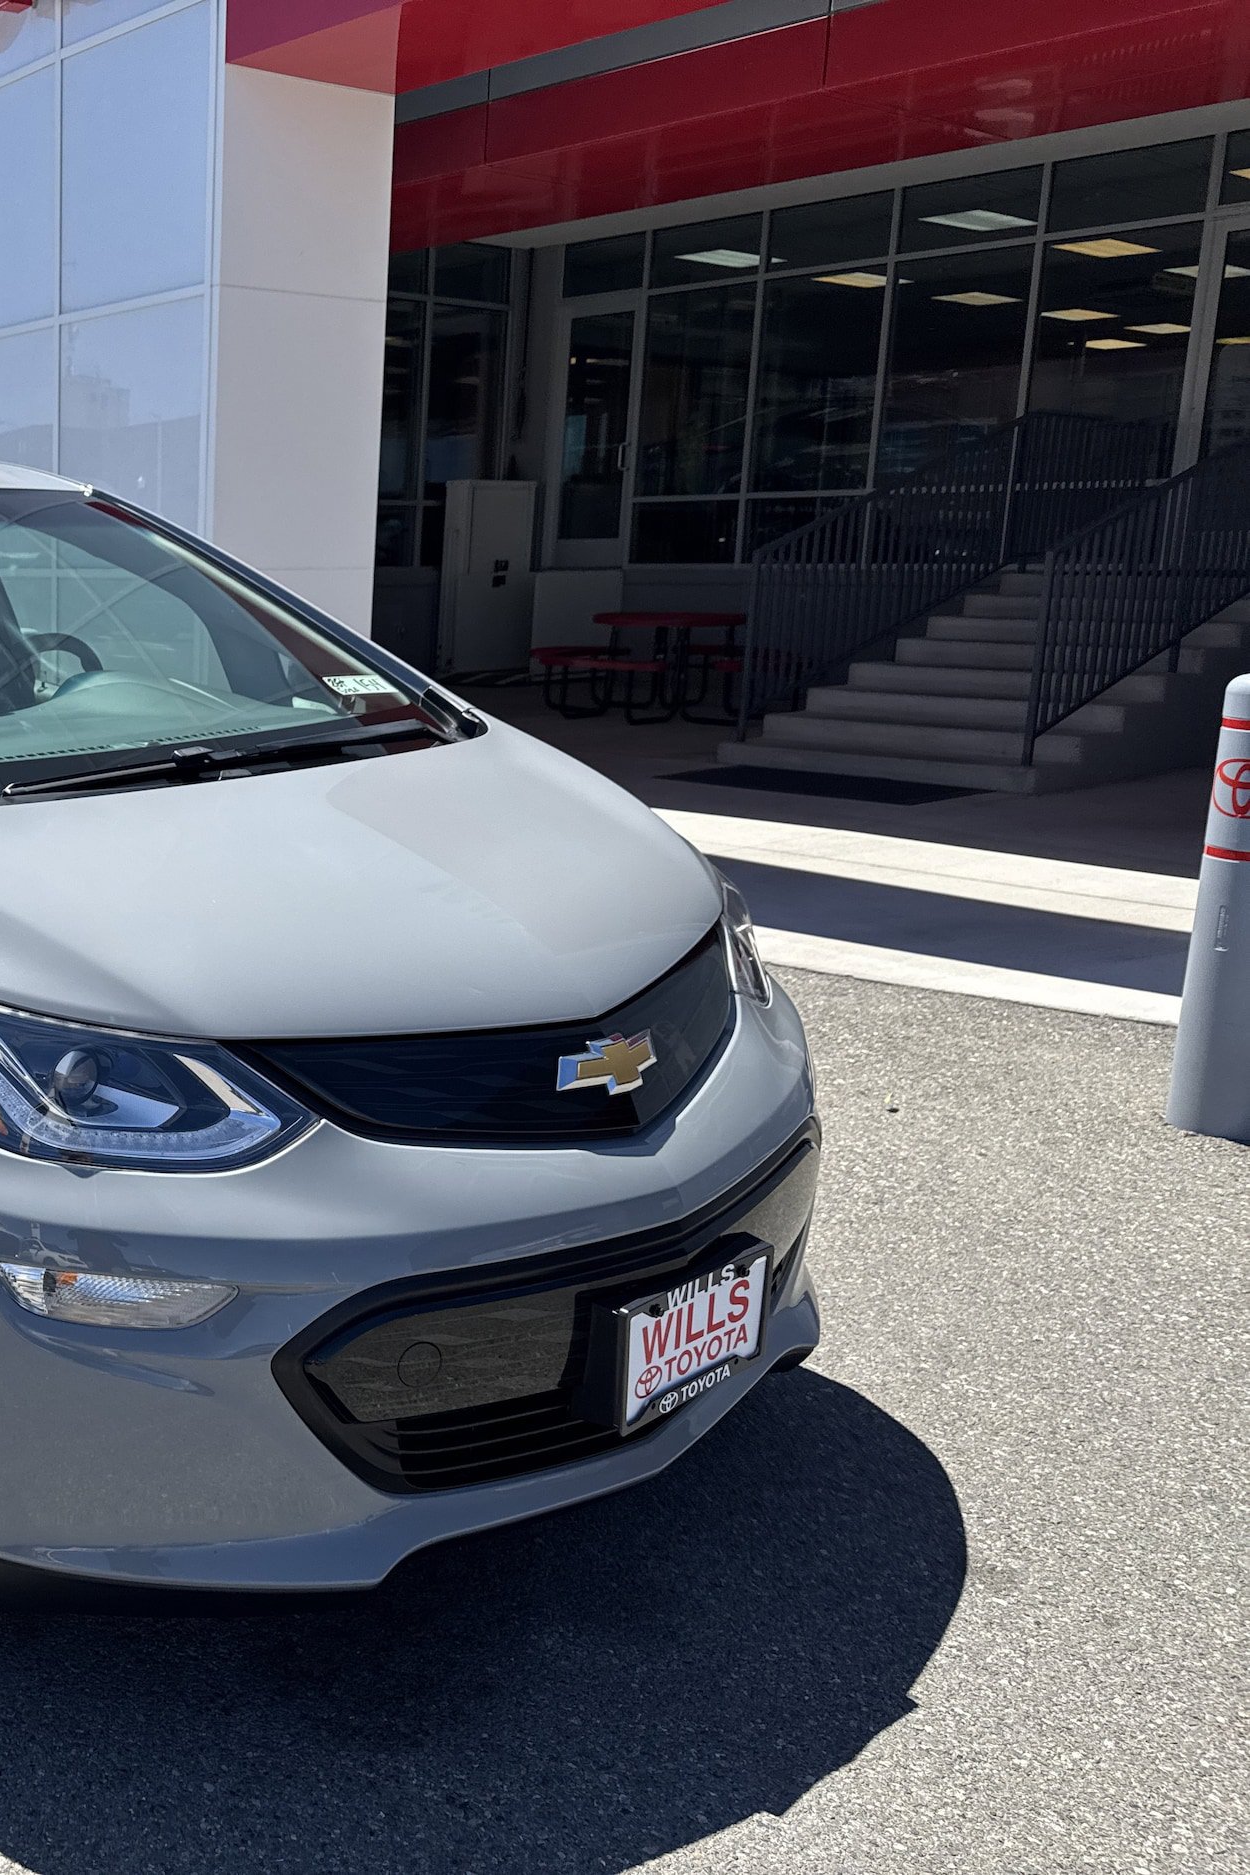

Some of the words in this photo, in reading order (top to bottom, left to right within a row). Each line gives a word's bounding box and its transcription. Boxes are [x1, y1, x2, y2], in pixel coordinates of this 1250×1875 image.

[666, 1263, 735, 1309] WILLS
[642, 1279, 750, 1365] WILLS
[664, 1323, 748, 1382] TOYOTA
[680, 1365, 731, 1401] TOYOTA
